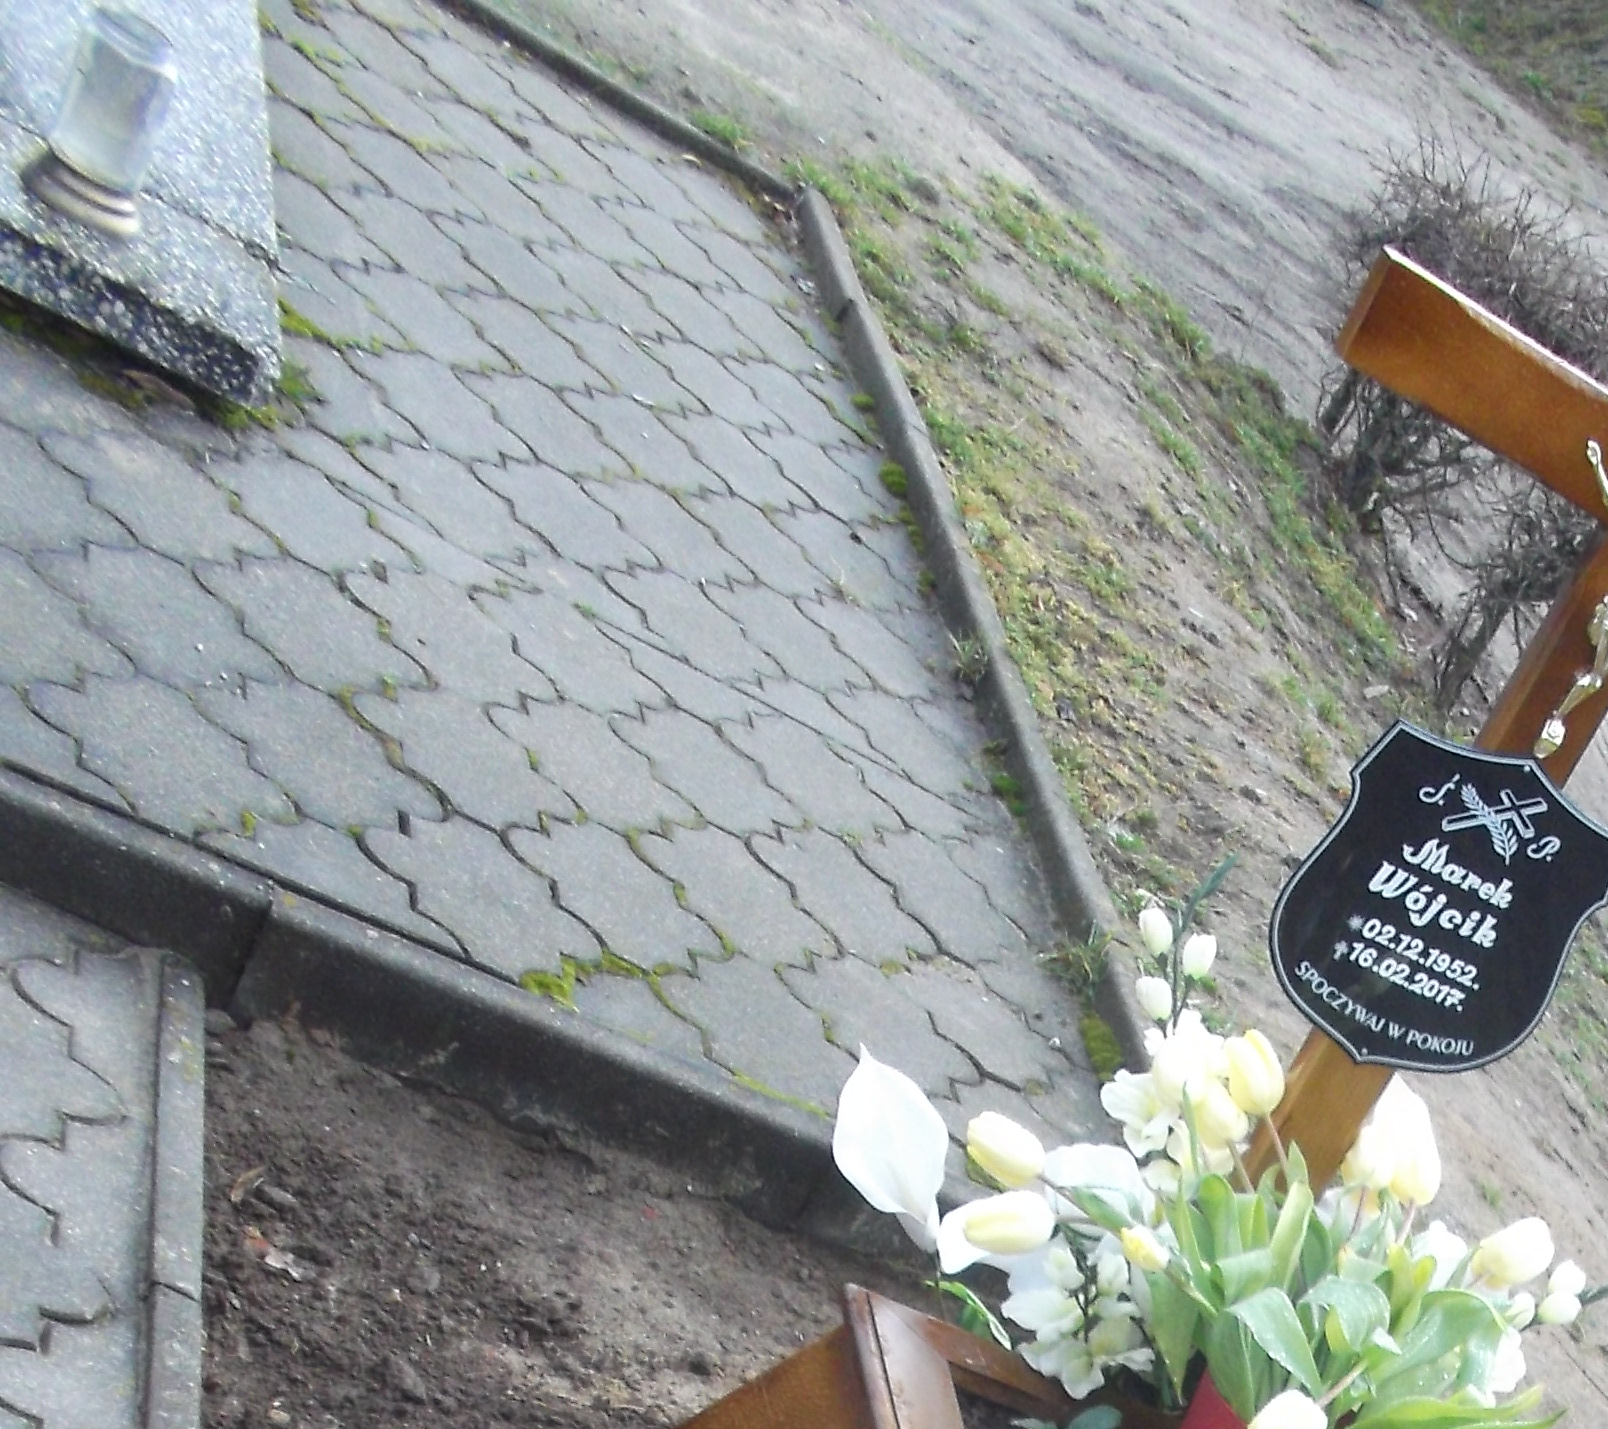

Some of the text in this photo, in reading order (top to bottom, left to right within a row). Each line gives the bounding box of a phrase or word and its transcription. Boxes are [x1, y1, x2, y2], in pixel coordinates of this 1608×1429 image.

[1402, 838, 1513, 909] Marek
[1526, 835, 1561, 862] P.
[1368, 860, 1498, 948] Wójcik
[1294, 960, 1475, 1056] SPOCZYWAJ W POKOJU
